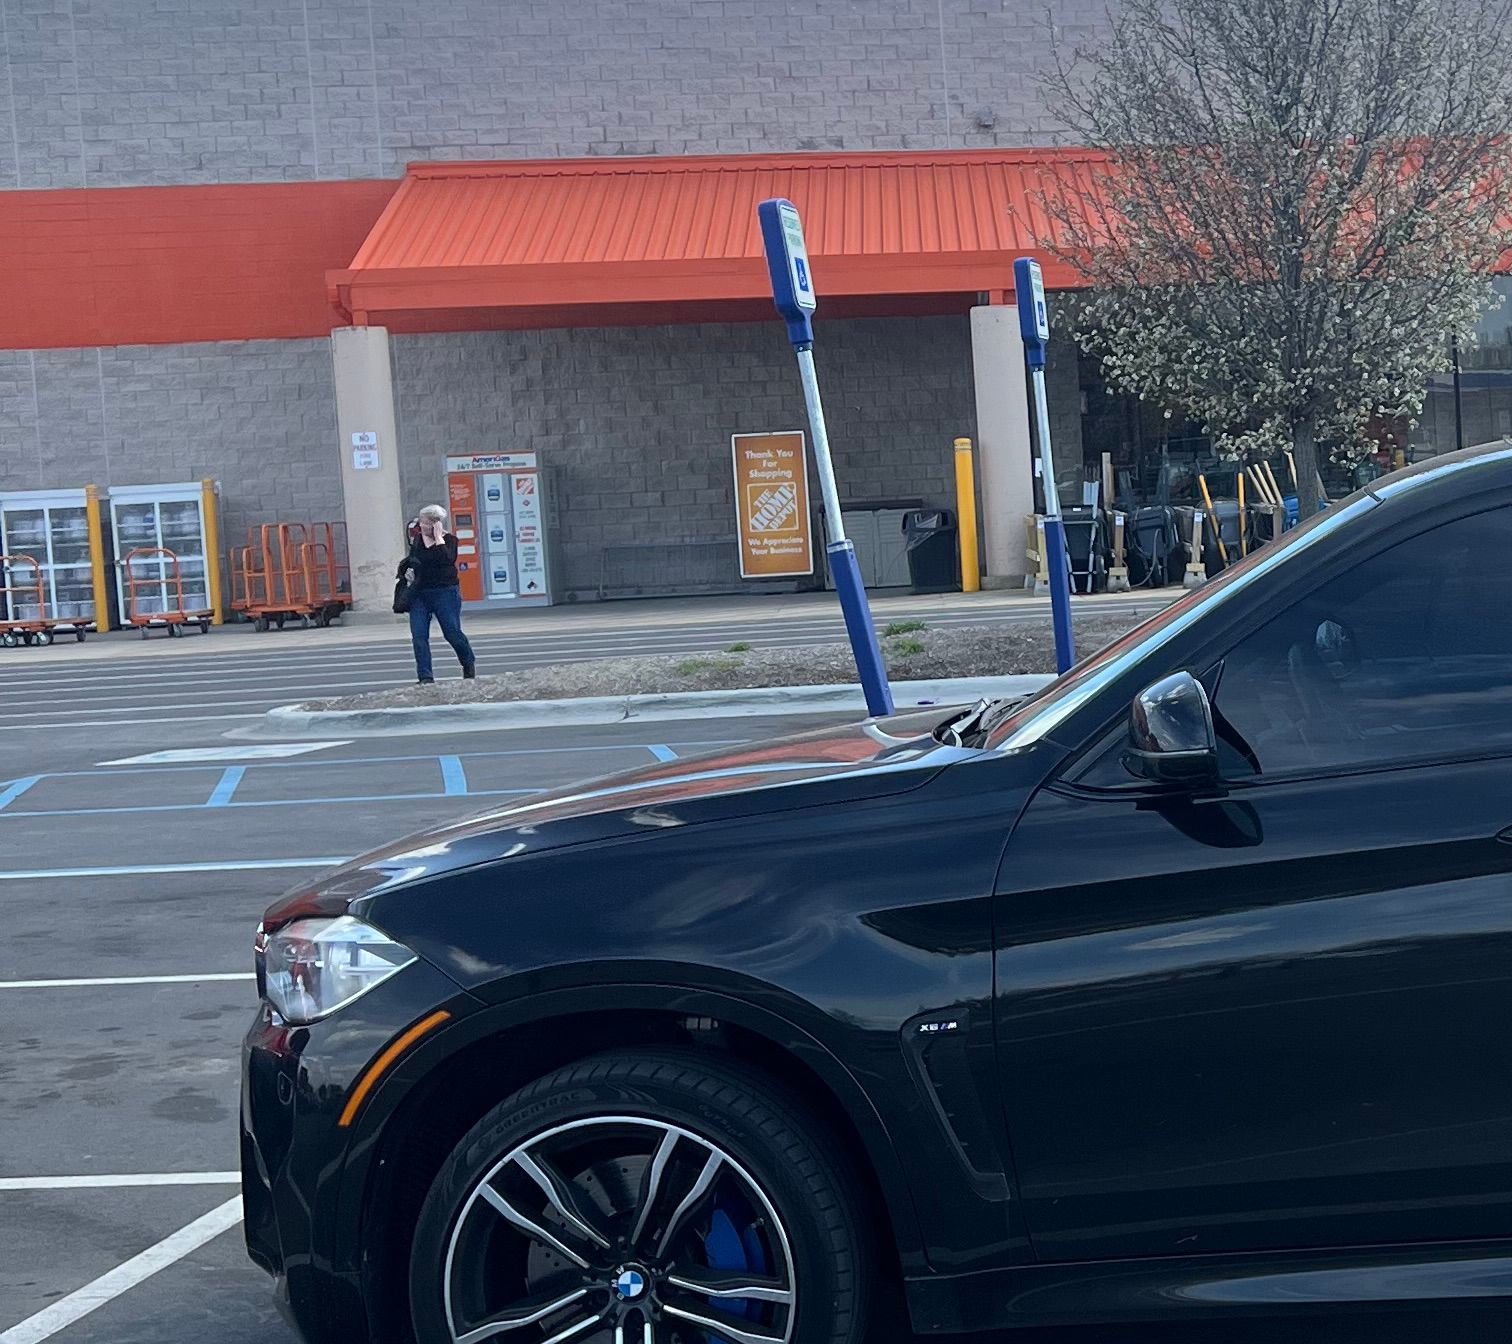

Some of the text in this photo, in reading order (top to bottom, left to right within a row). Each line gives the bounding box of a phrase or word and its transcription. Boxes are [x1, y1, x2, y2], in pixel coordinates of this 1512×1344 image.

[745, 448, 794, 460] Thank You
[761, 459, 778, 468] For
[749, 469, 793, 479] Shopping
[753, 488, 773, 508] THE
[751, 484, 796, 531] HOME
[748, 536, 804, 547] We Appreciate
[751, 545, 803, 555] Your Business
[495, 1091, 583, 1133] GREENTRAC
